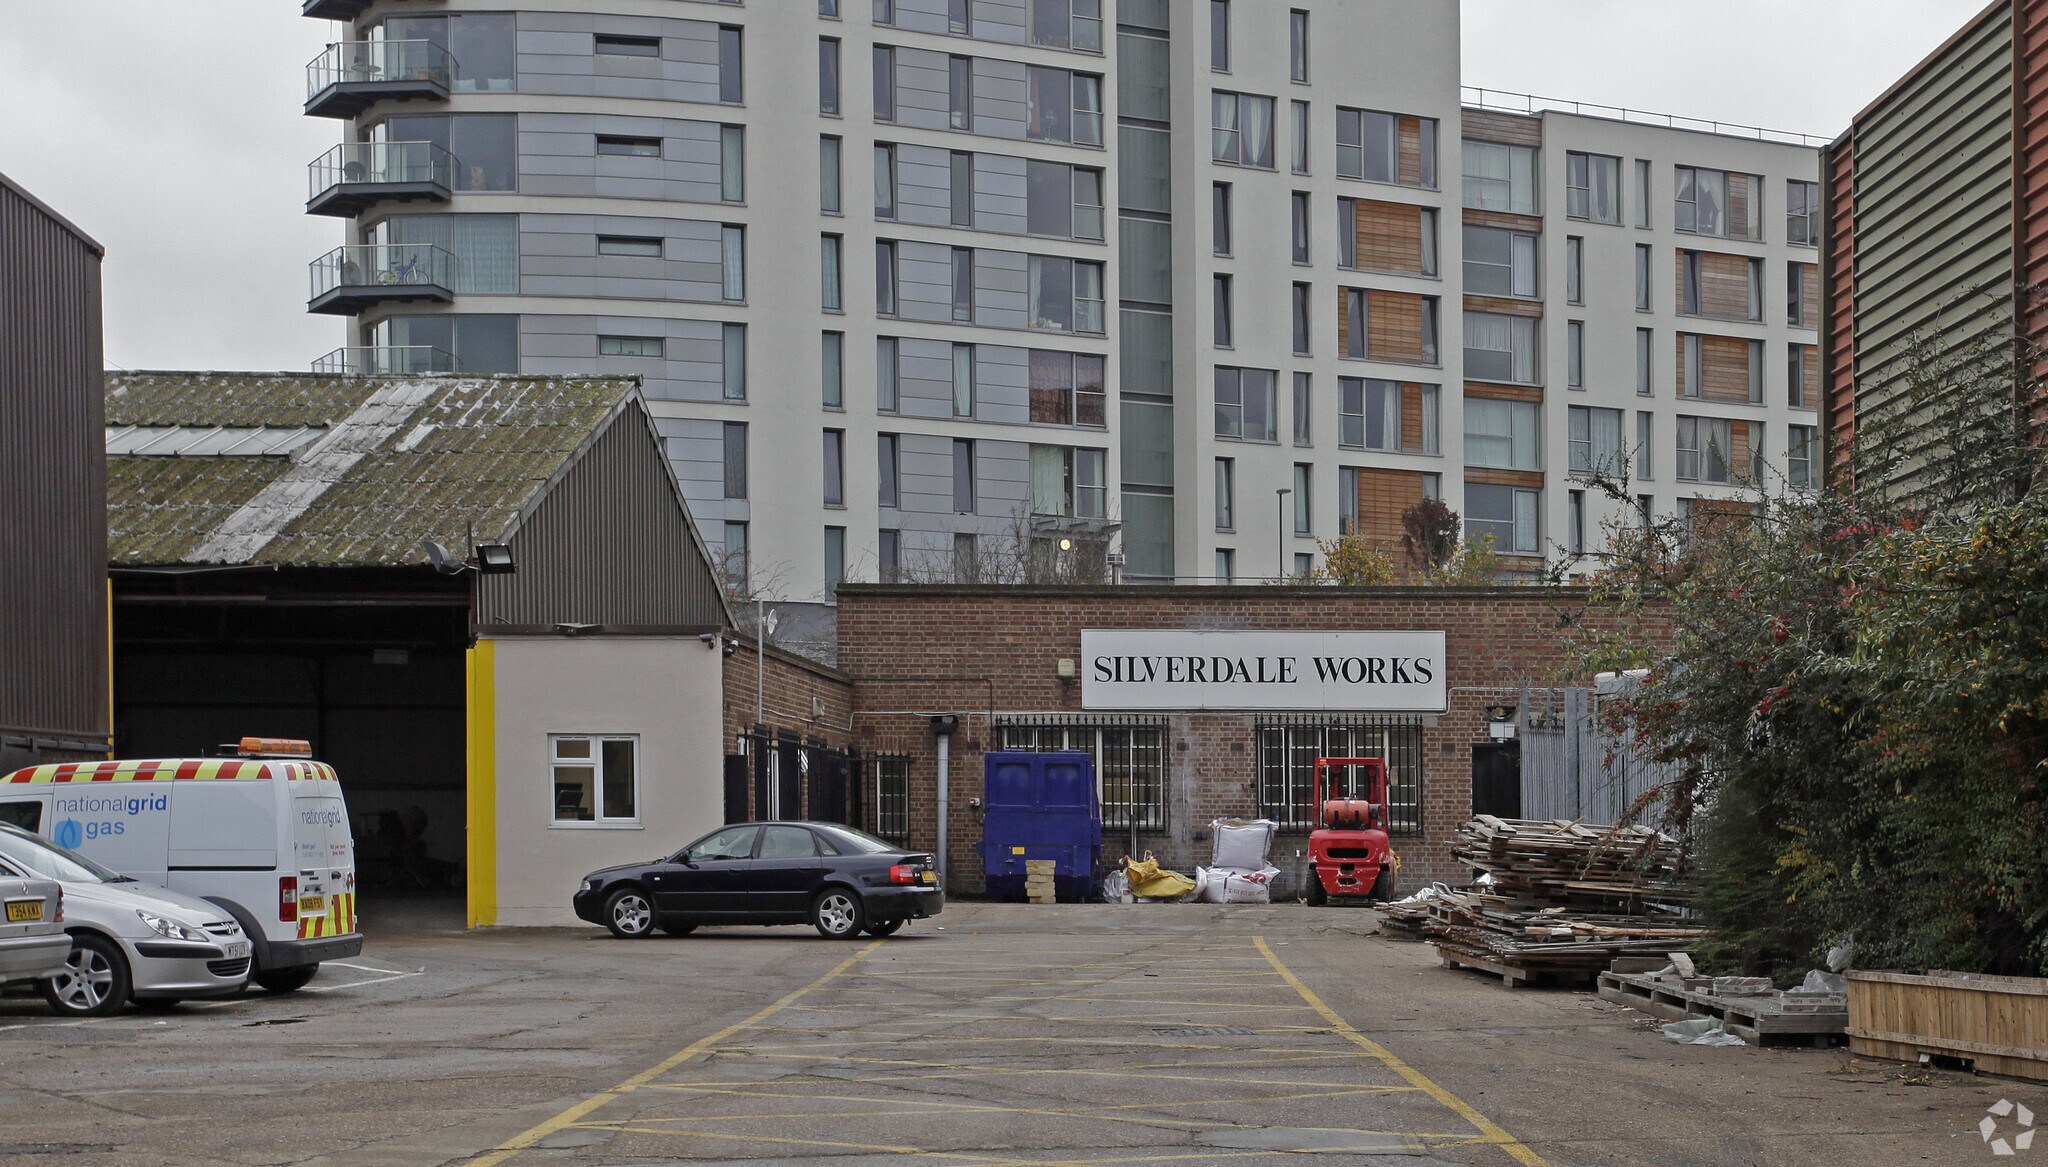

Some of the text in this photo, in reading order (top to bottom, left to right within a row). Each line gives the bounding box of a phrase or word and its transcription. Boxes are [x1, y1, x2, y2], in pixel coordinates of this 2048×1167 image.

[1094, 655, 1434, 685] SILVERDALE WORKS
[56, 792, 167, 816] nationalgrid
[301, 805, 341, 828] nationalgrid
[86, 821, 125, 840] gas
[9, 903, 27, 919] T354
